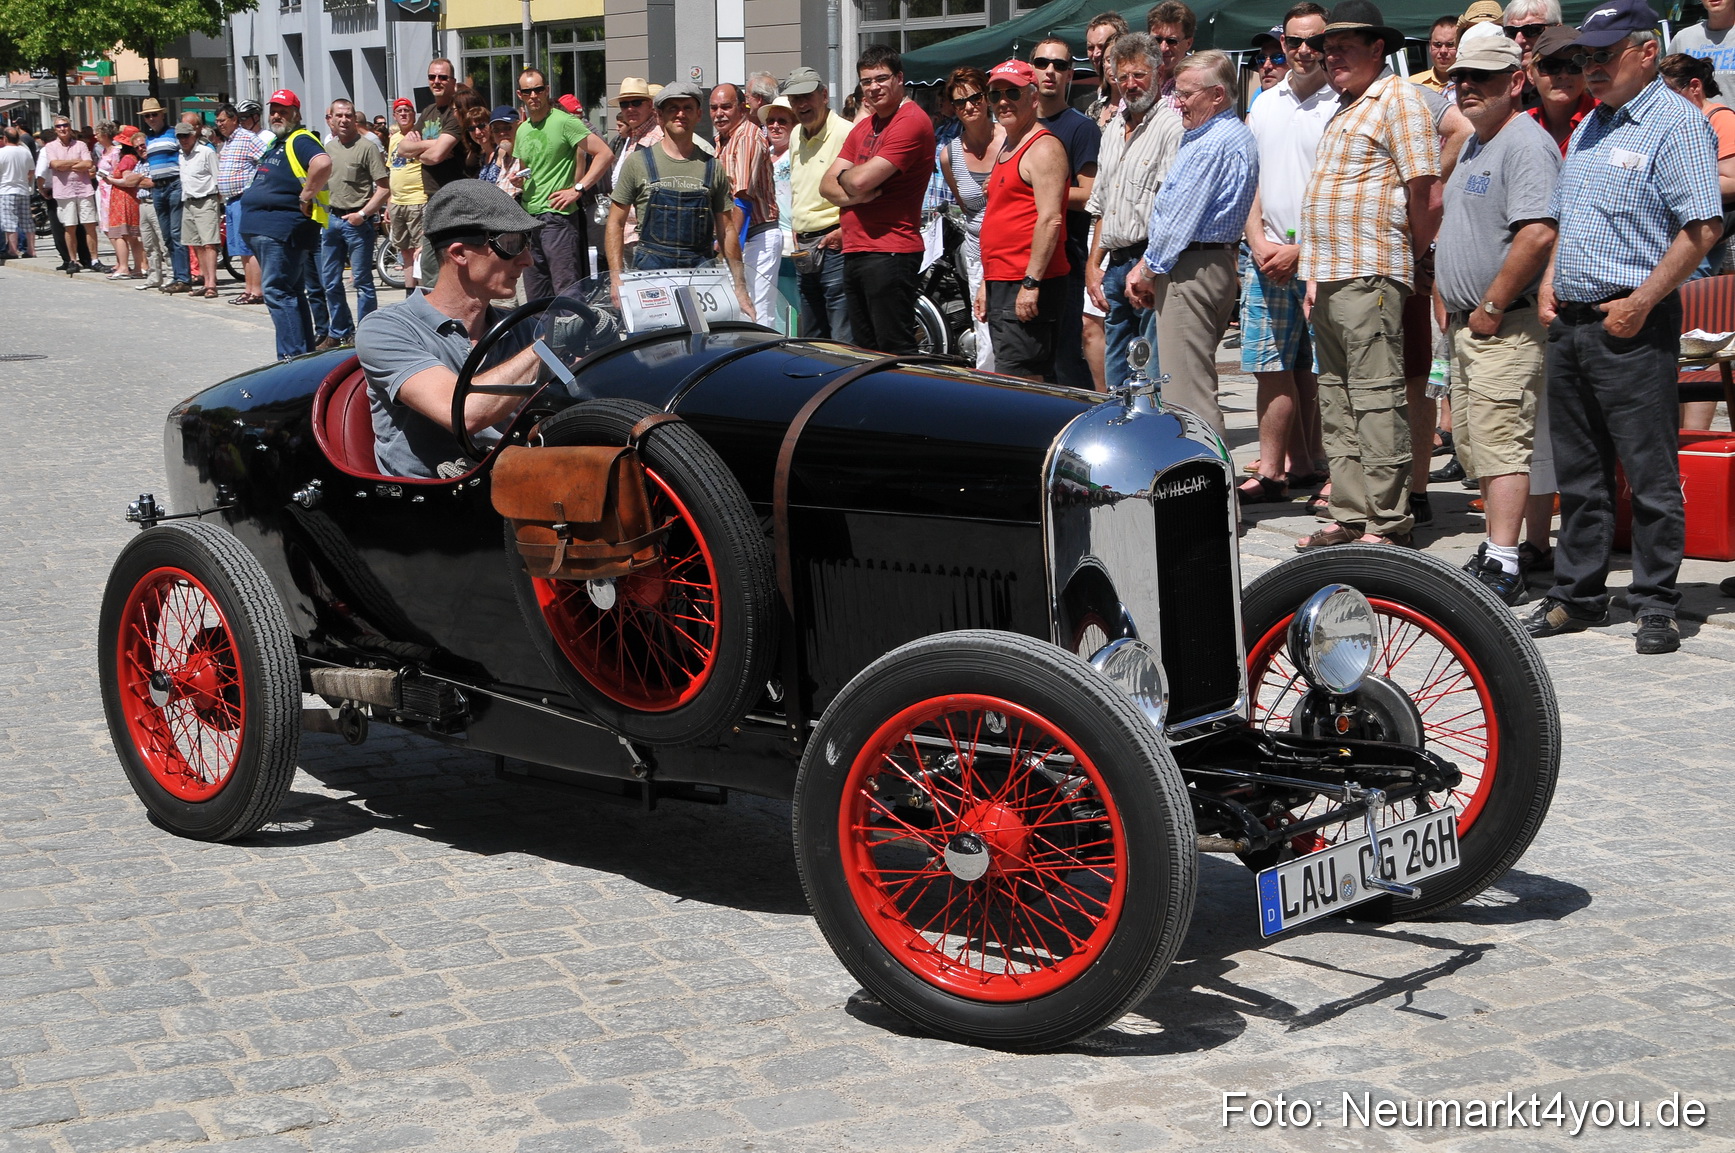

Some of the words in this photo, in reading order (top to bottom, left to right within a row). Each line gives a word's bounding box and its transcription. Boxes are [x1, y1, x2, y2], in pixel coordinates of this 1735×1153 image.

[1153, 475, 1207, 500] AMILCAR
[1280, 857, 1338, 920] LAU
[1358, 837, 1396, 890] CG
[1402, 815, 1457, 876] 26H
[1267, 908, 1275, 922] D
